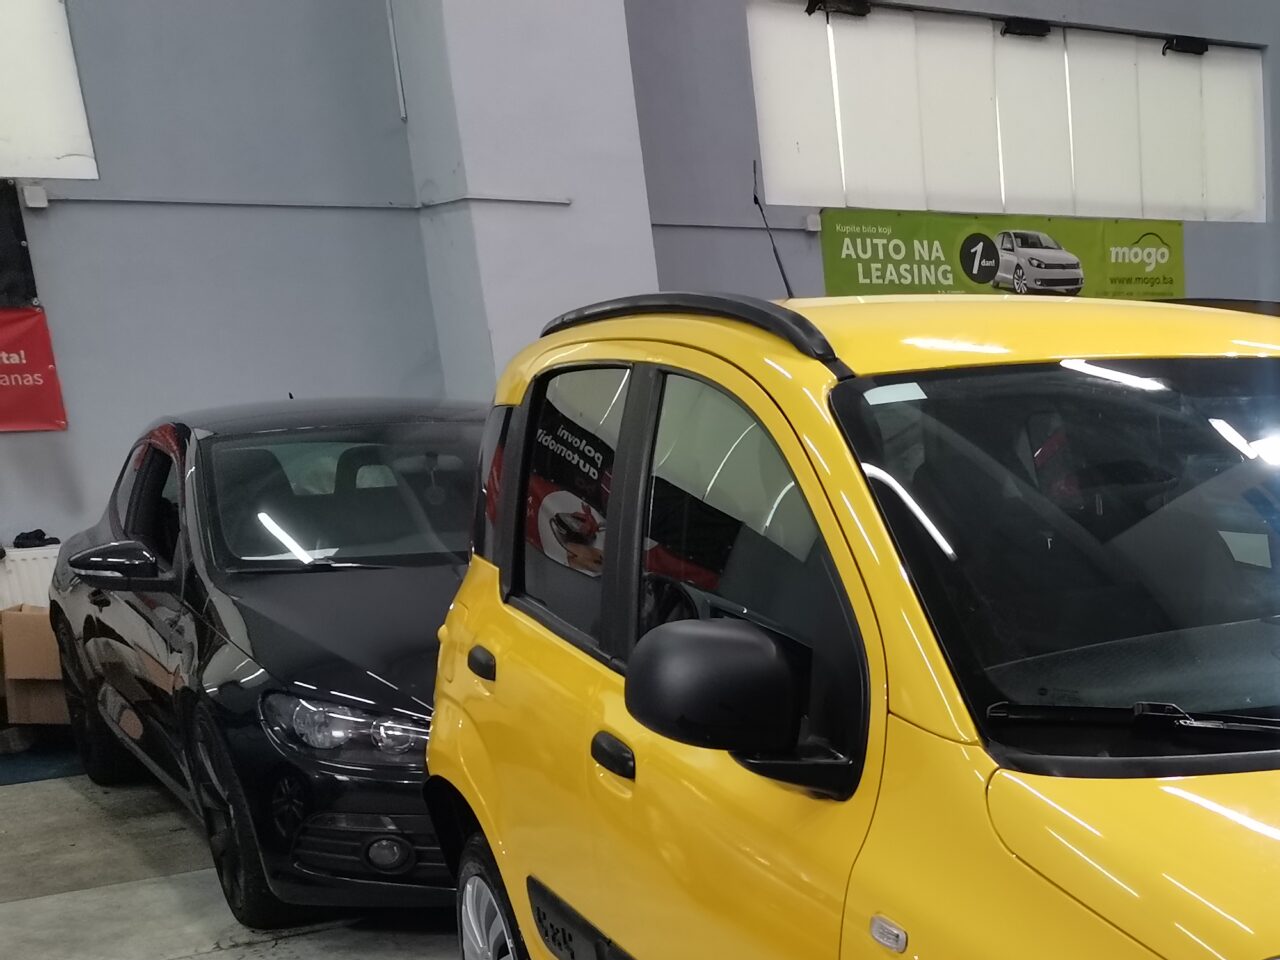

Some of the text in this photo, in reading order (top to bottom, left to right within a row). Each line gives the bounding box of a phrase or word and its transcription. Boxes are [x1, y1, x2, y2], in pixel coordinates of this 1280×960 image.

[835, 223, 892, 236] Kupite bilo koji
[841, 237, 945, 261] AUTO NA
[970, 241, 984, 275] 1
[1110, 246, 1170, 273] mogo
[857, 262, 954, 286] LEASING
[1109, 275, 1174, 287] www.mogo.ba
[0, 349, 27, 364] ta!
